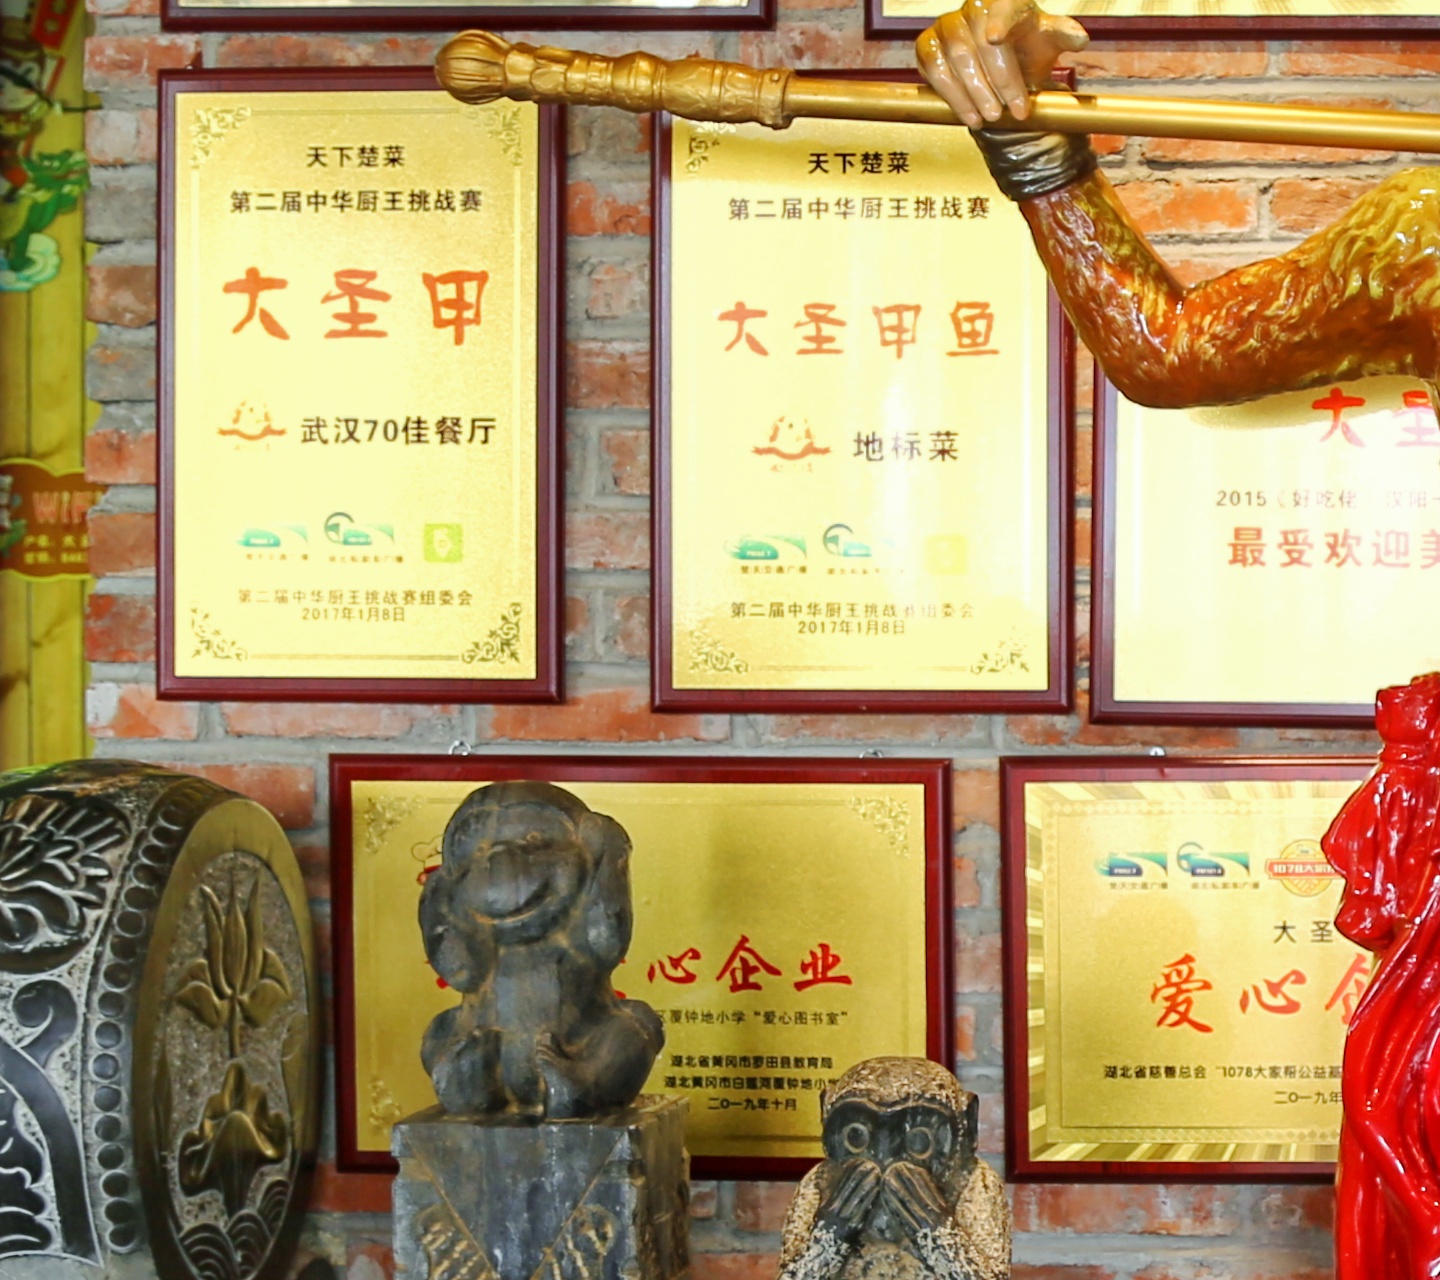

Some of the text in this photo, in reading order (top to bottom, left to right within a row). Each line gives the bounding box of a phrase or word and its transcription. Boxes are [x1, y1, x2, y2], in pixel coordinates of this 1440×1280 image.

[306, 145, 406, 169] 天下楚菜
[808, 152, 911, 175] 天下楚菜
[230, 190, 483, 214] 第二届中华厨王挑战赛
[728, 197, 991, 221] 第二届中华厨王挑战赛
[222, 266, 490, 347] 大圣甲
[717, 300, 1001, 360] 大圣甲鱼
[300, 415, 497, 447] 武汉70佳餐厅
[852, 431, 960, 463] 地标菜
[238, 589, 473, 606] 第二届中华厨王挑战赛组委会
[302, 606, 406, 622] 2017年1月8日
[798, 620, 906, 636] 2017年1月8日
[1273, 921, 1334, 945] 大圣
[615, 935, 854, 999] 心企业
[1104, 1064, 1207, 1080] 湖北省慈善总会
